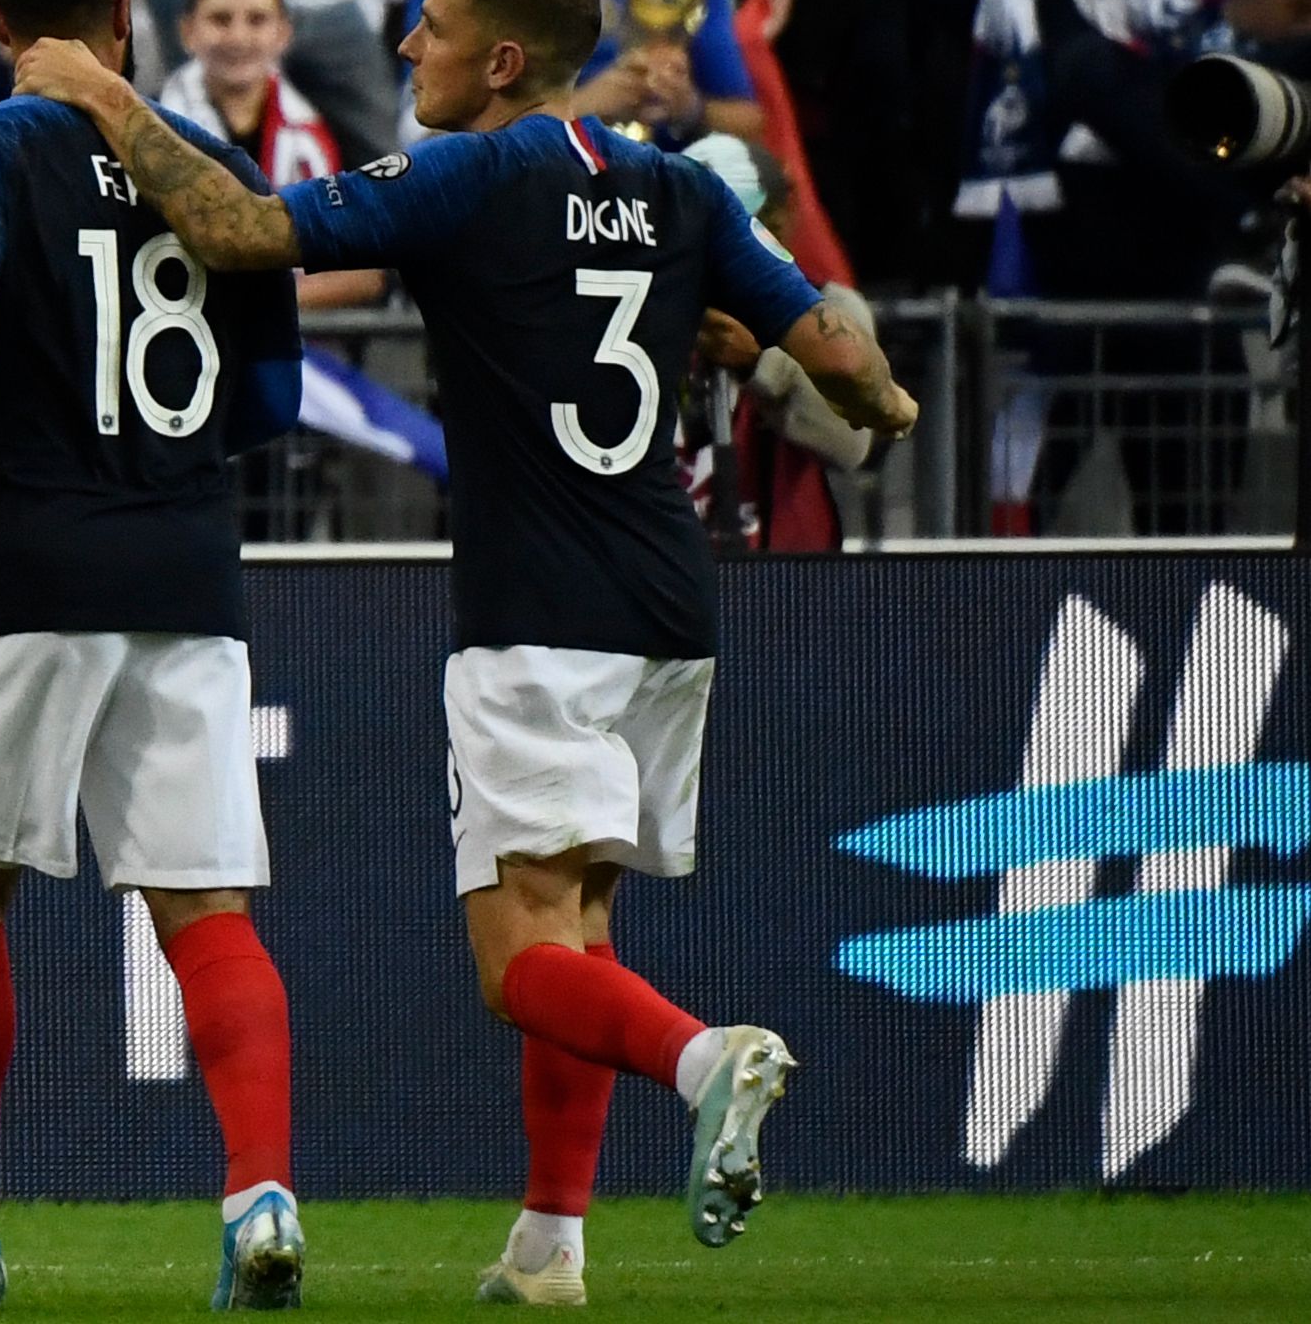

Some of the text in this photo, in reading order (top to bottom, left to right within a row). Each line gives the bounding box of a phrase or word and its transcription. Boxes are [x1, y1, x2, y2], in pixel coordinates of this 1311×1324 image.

[567, 193, 658, 247] DIGNE
[78, 229, 220, 438] 18
[551, 268, 660, 475] 3
